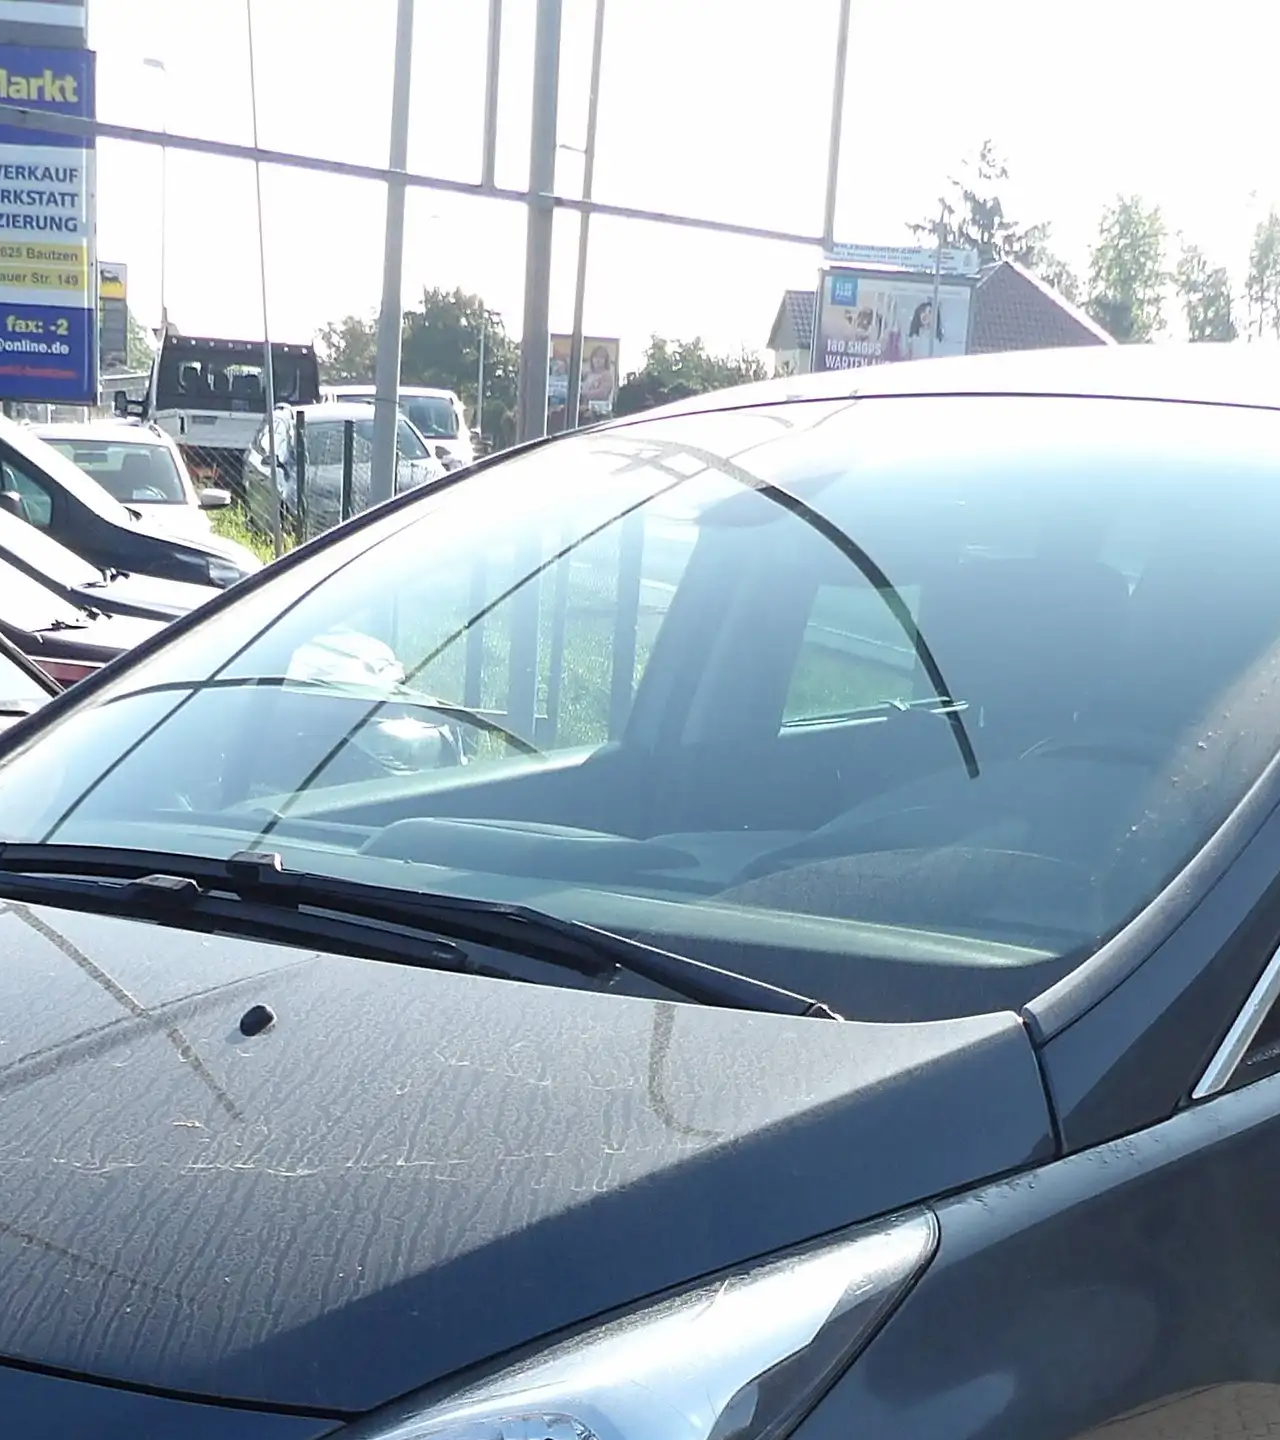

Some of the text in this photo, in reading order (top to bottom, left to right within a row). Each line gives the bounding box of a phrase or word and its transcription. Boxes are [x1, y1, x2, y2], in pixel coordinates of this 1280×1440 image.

[26, 248, 78, 262] Bautzen
[31, 272, 52, 285] Str.
[58, 274, 79, 286] 149
[6, 315, 43, 333] fax:
[49, 318, 69, 335] -2
[847, 341, 882, 355] SHOPS
